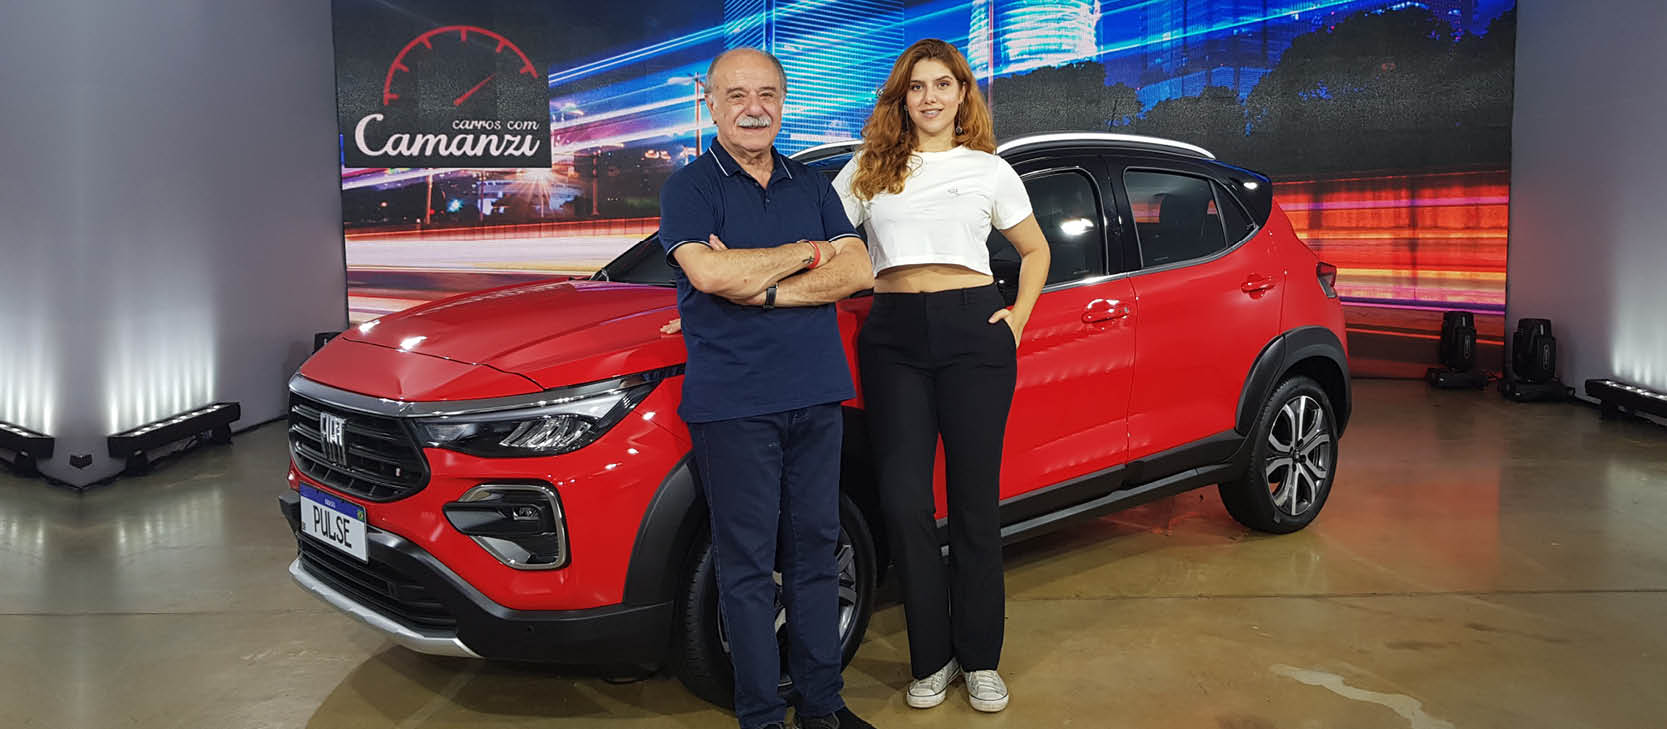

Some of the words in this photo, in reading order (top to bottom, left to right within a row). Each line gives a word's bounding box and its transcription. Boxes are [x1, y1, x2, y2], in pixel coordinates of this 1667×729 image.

[354, 113, 541, 157] Camanzi
[452, 119, 502, 130] carros
[507, 120, 539, 130] com
[312, 504, 353, 549] PULSE
